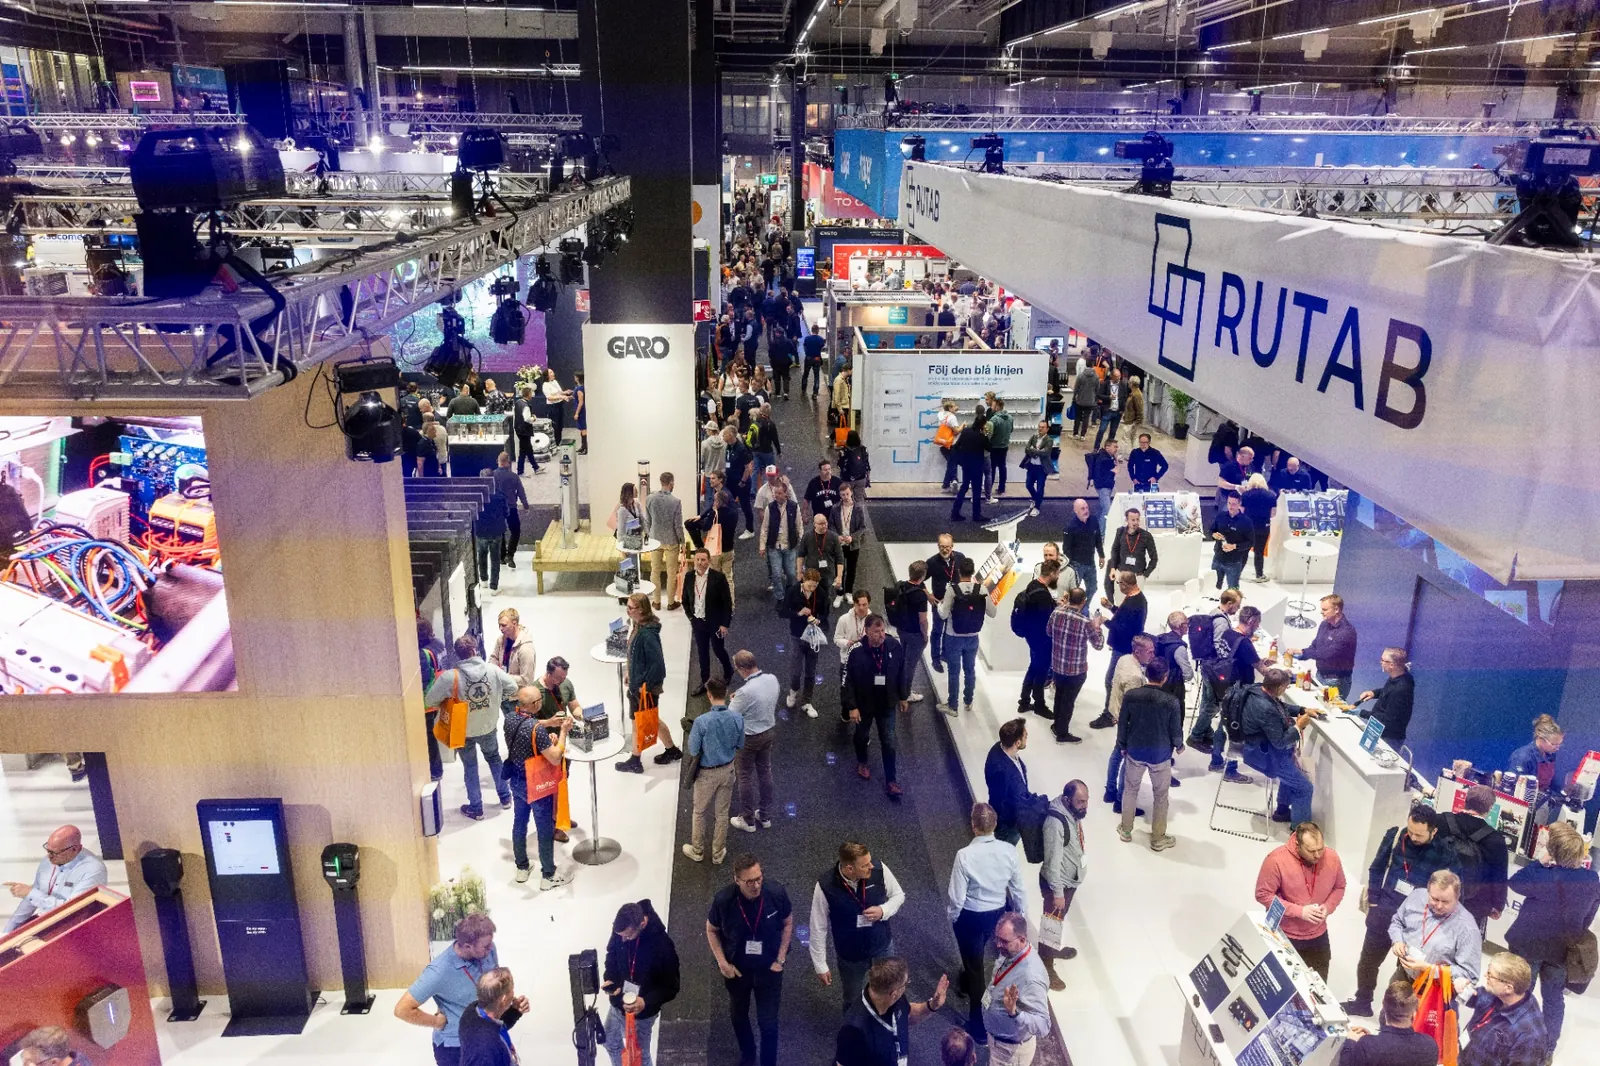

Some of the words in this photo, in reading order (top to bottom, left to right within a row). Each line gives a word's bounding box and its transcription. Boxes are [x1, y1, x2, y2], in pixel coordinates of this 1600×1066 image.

[834, 197, 852, 207] TO
[916, 184, 940, 222] RUTAB
[607, 336, 670, 359] GARO
[1215, 271, 1432, 430] RUTAB
[928, 365, 948, 376] Följ
[951, 365, 971, 375] den
[974, 364, 991, 375] blå
[995, 365, 1023, 376] linjen
